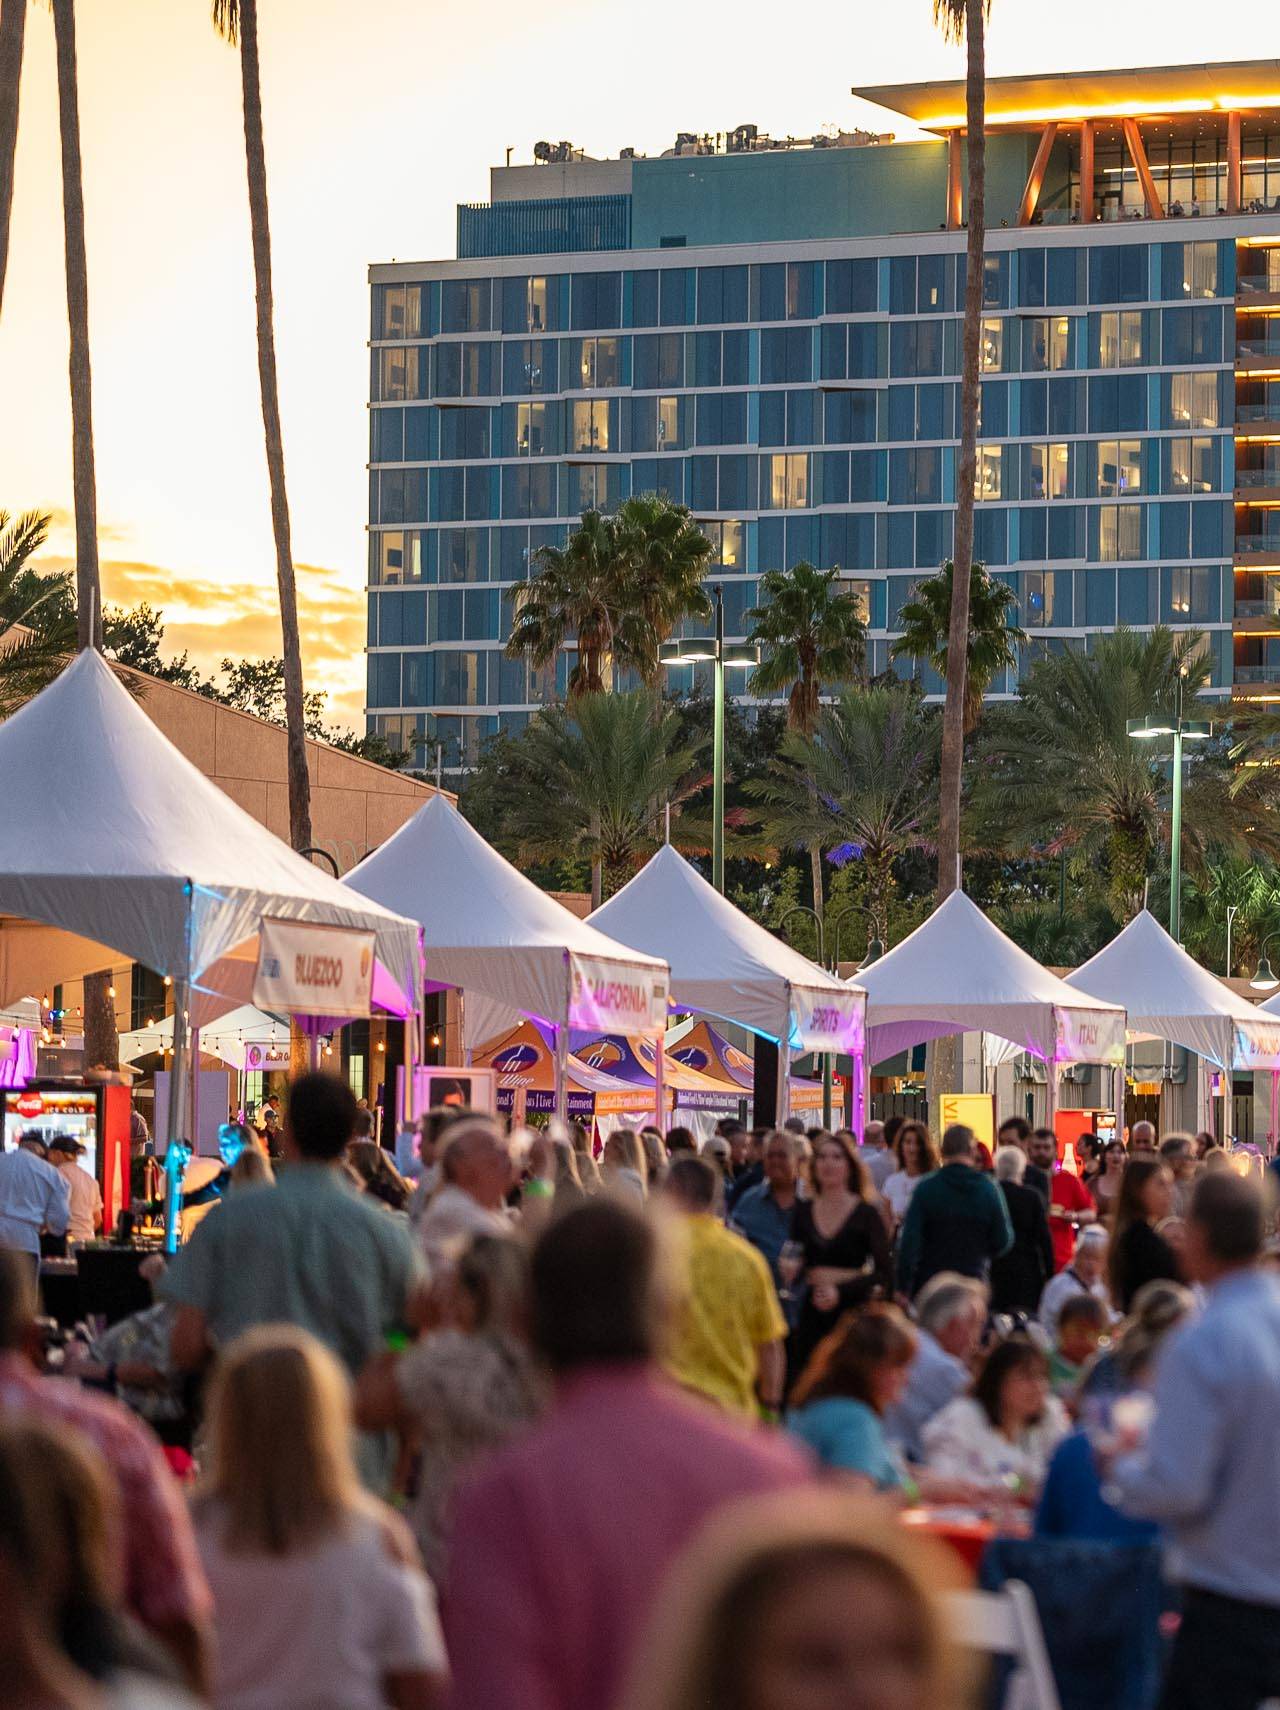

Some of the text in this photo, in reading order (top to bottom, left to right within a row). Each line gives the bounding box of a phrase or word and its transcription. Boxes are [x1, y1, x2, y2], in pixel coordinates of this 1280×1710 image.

[295, 953, 343, 988] BLUEZOO
[1079, 1024, 1099, 1044] ITALY
[46, 1106, 86, 1114] ICE COLD
